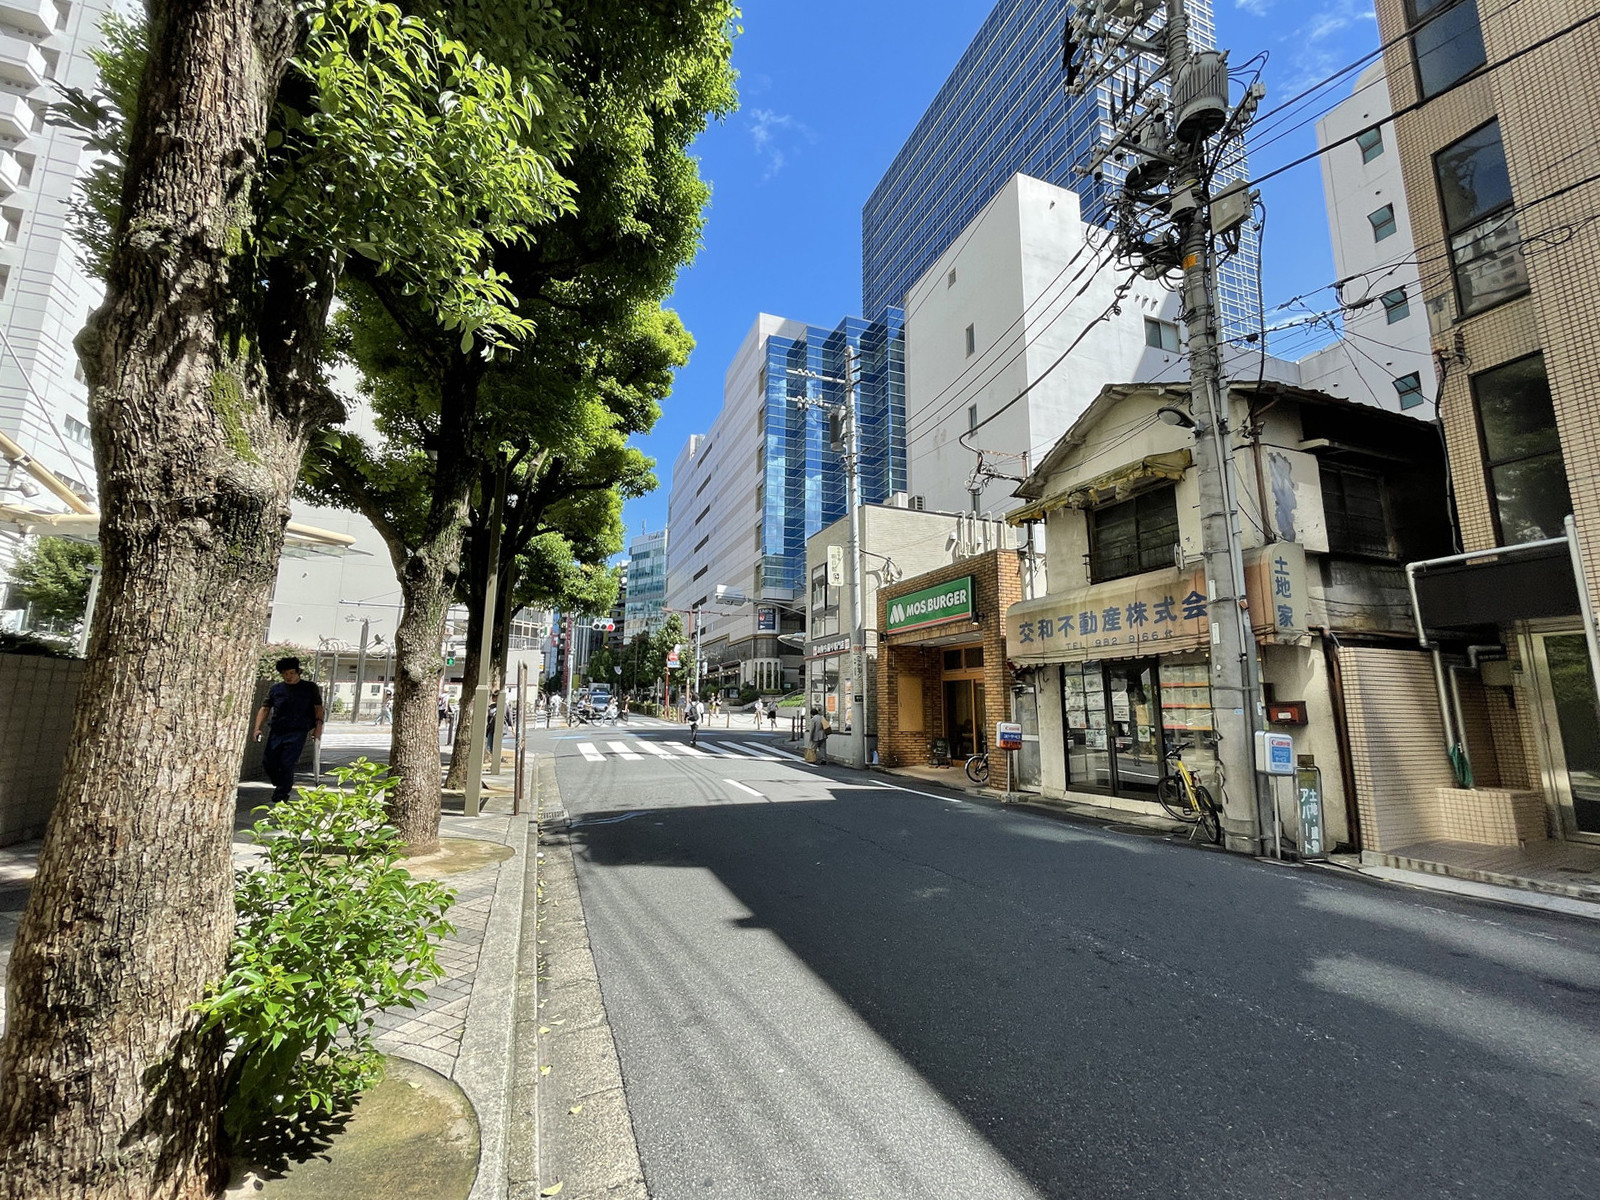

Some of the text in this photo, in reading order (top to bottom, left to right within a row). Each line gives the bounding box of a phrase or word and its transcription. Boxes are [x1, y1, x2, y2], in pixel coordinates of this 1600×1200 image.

[906, 589, 967, 618] MOS BURGER
[1065, 641, 1086, 651] TEL
